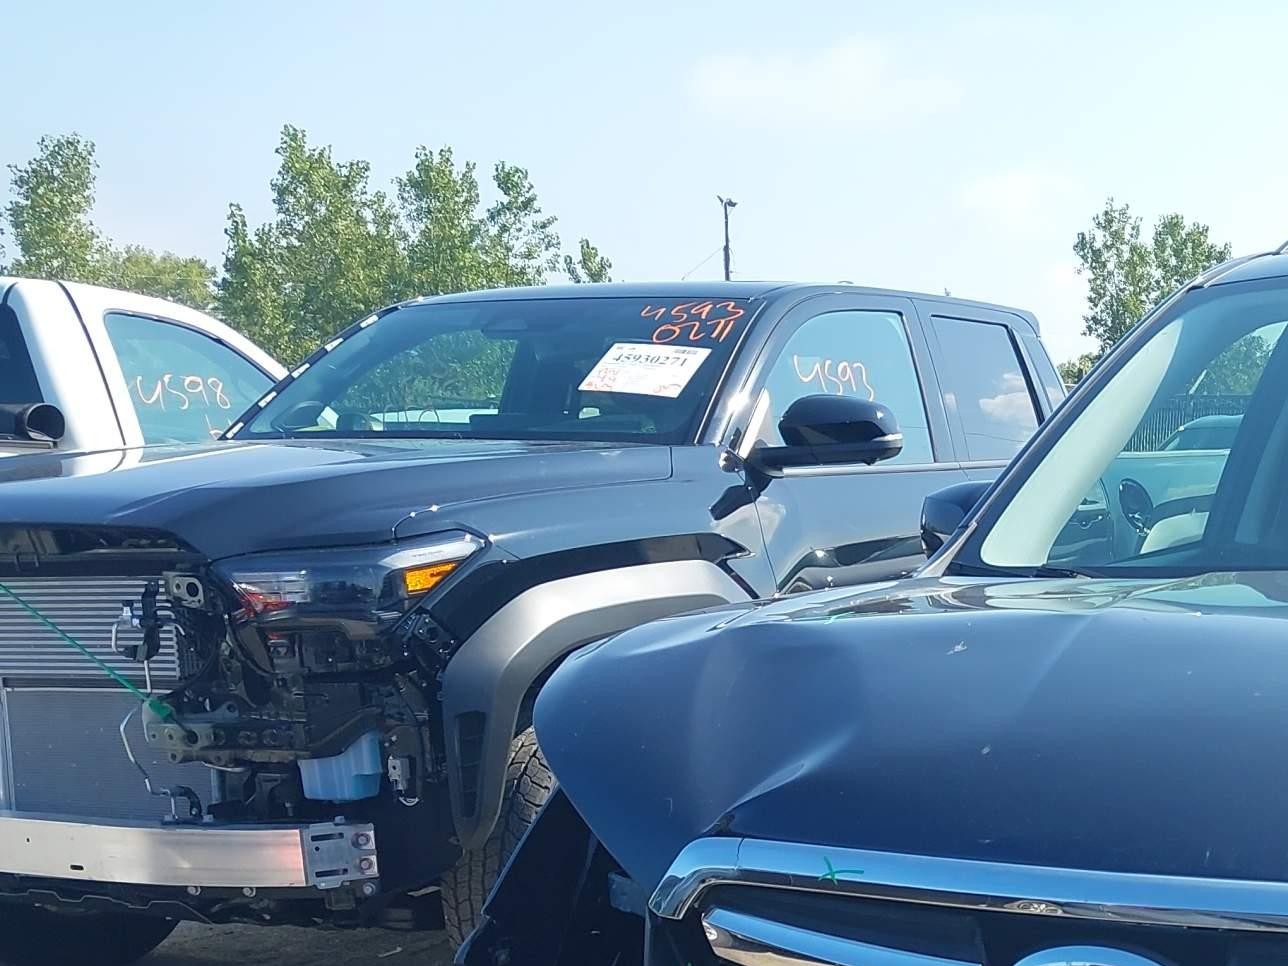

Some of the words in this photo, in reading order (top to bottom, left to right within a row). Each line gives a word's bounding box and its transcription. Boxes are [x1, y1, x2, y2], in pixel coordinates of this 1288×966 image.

[640, 301, 745, 324] 4593
[612, 352, 688, 367] 45930271
[136, 374, 231, 410] 4598
[793, 354, 874, 402] 4593
